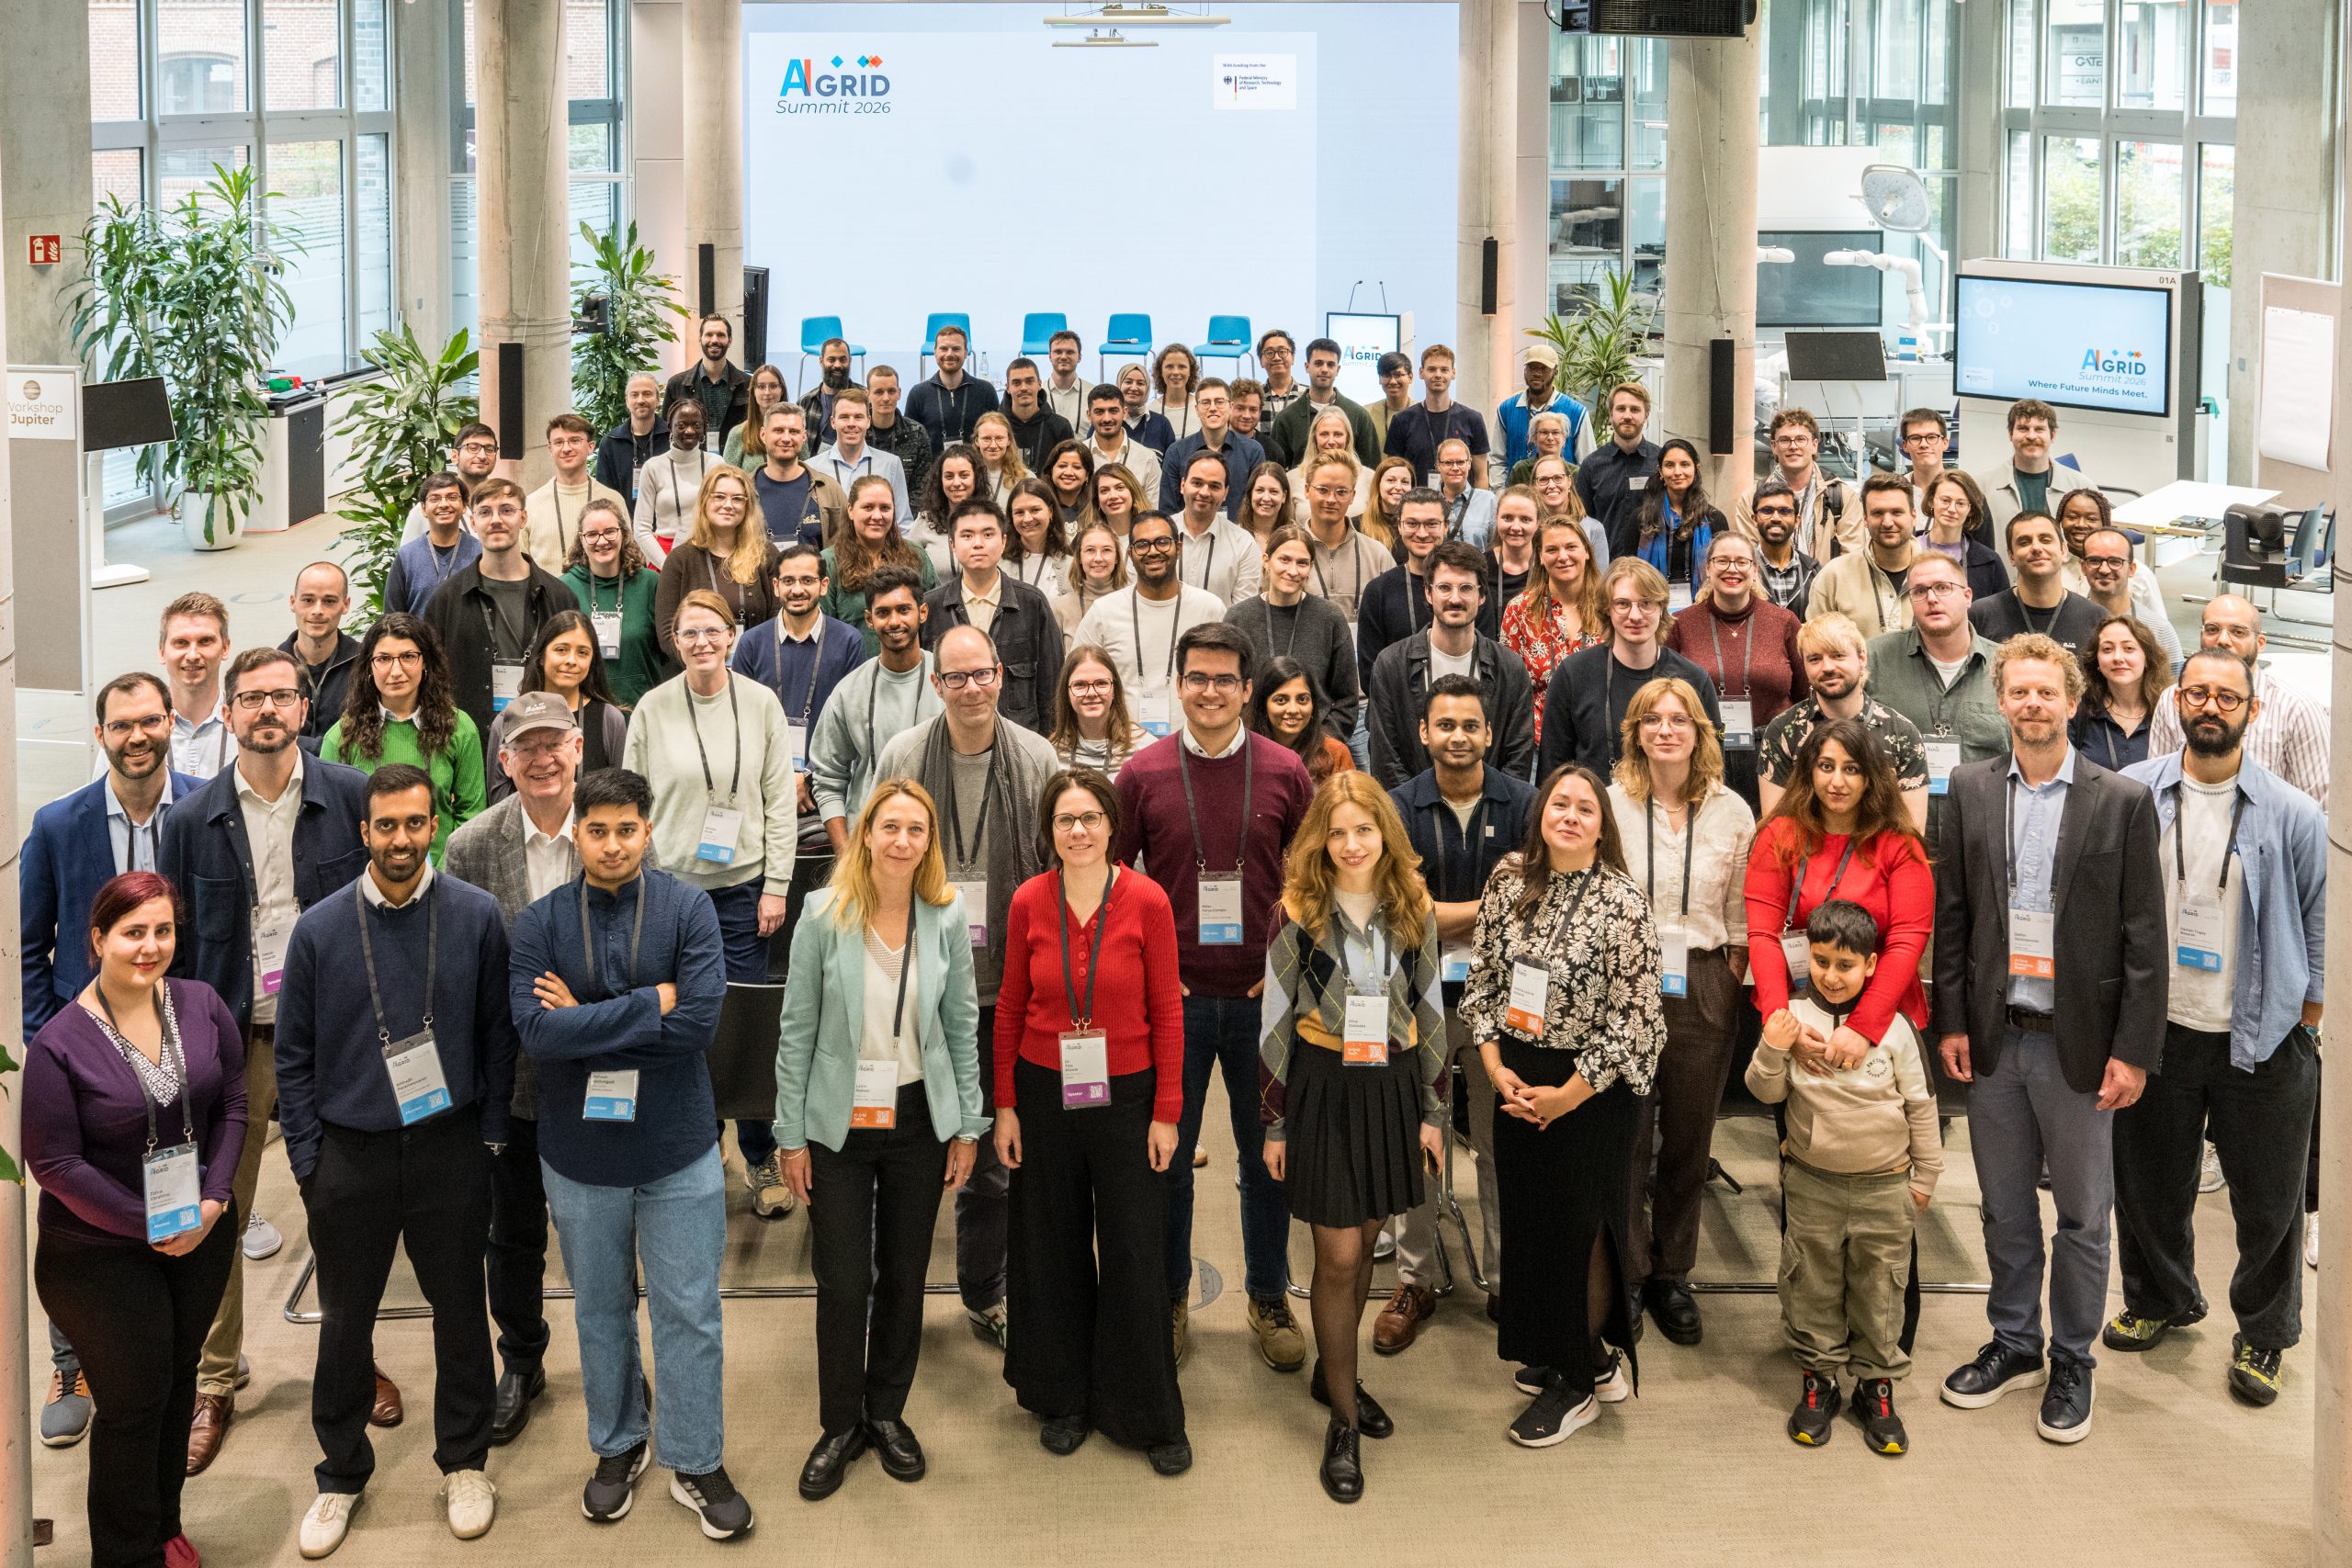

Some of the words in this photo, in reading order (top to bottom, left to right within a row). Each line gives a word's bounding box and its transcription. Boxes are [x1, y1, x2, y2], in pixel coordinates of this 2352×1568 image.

[775, 99, 849, 113] Summit
[854, 101, 891, 113] 2026
[2159, 276, 2176, 285] 01A
[2078, 371, 2122, 384] Summit
[2123, 378, 2146, 386] 2026
[2028, 379, 2058, 389] Where
[2060, 383, 2089, 392] Future
[2092, 387, 2120, 396] Minds
[2122, 389, 2148, 399] Meet.
[11, 413, 55, 426] Jupiter
